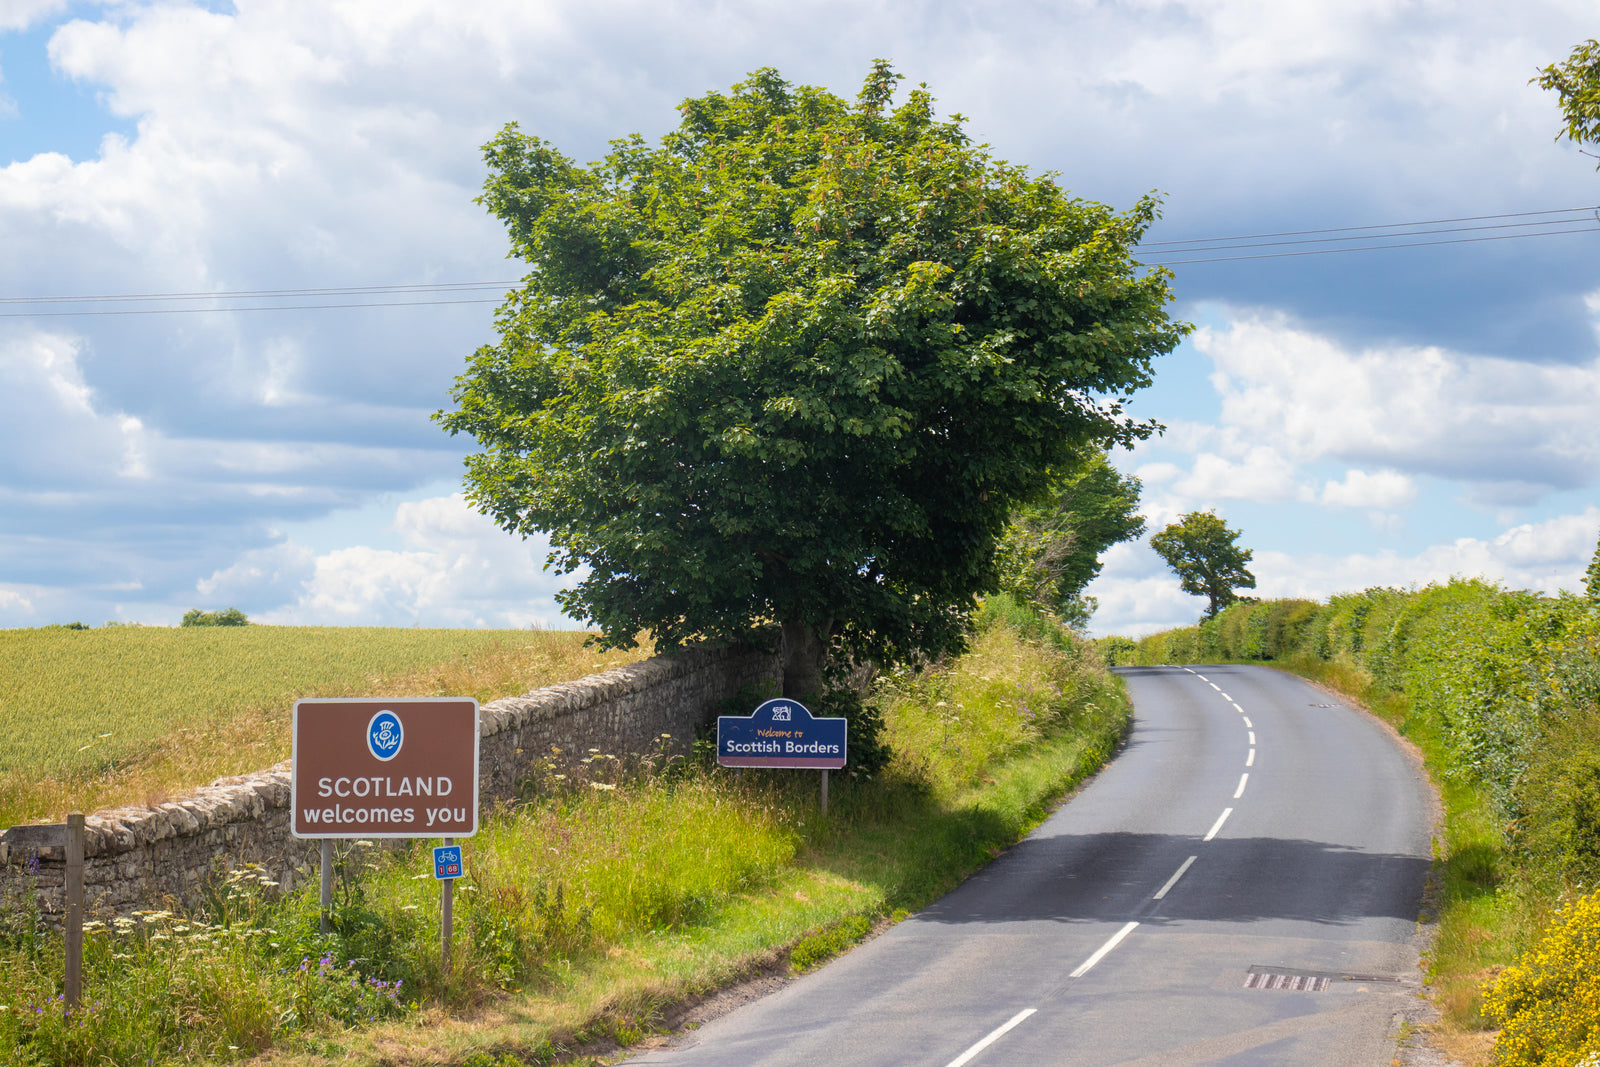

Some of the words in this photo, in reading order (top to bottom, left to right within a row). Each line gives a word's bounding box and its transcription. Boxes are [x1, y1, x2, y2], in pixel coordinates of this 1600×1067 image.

[757, 727, 792, 738] Welcome
[794, 730, 804, 738] to
[726, 740, 781, 753] Scottish
[785, 741, 840, 754] Borders
[318, 777, 452, 797] SCOTLAND
[303, 804, 415, 823] welcomes
[426, 807, 466, 826] you
[448, 865, 458, 873] 68
